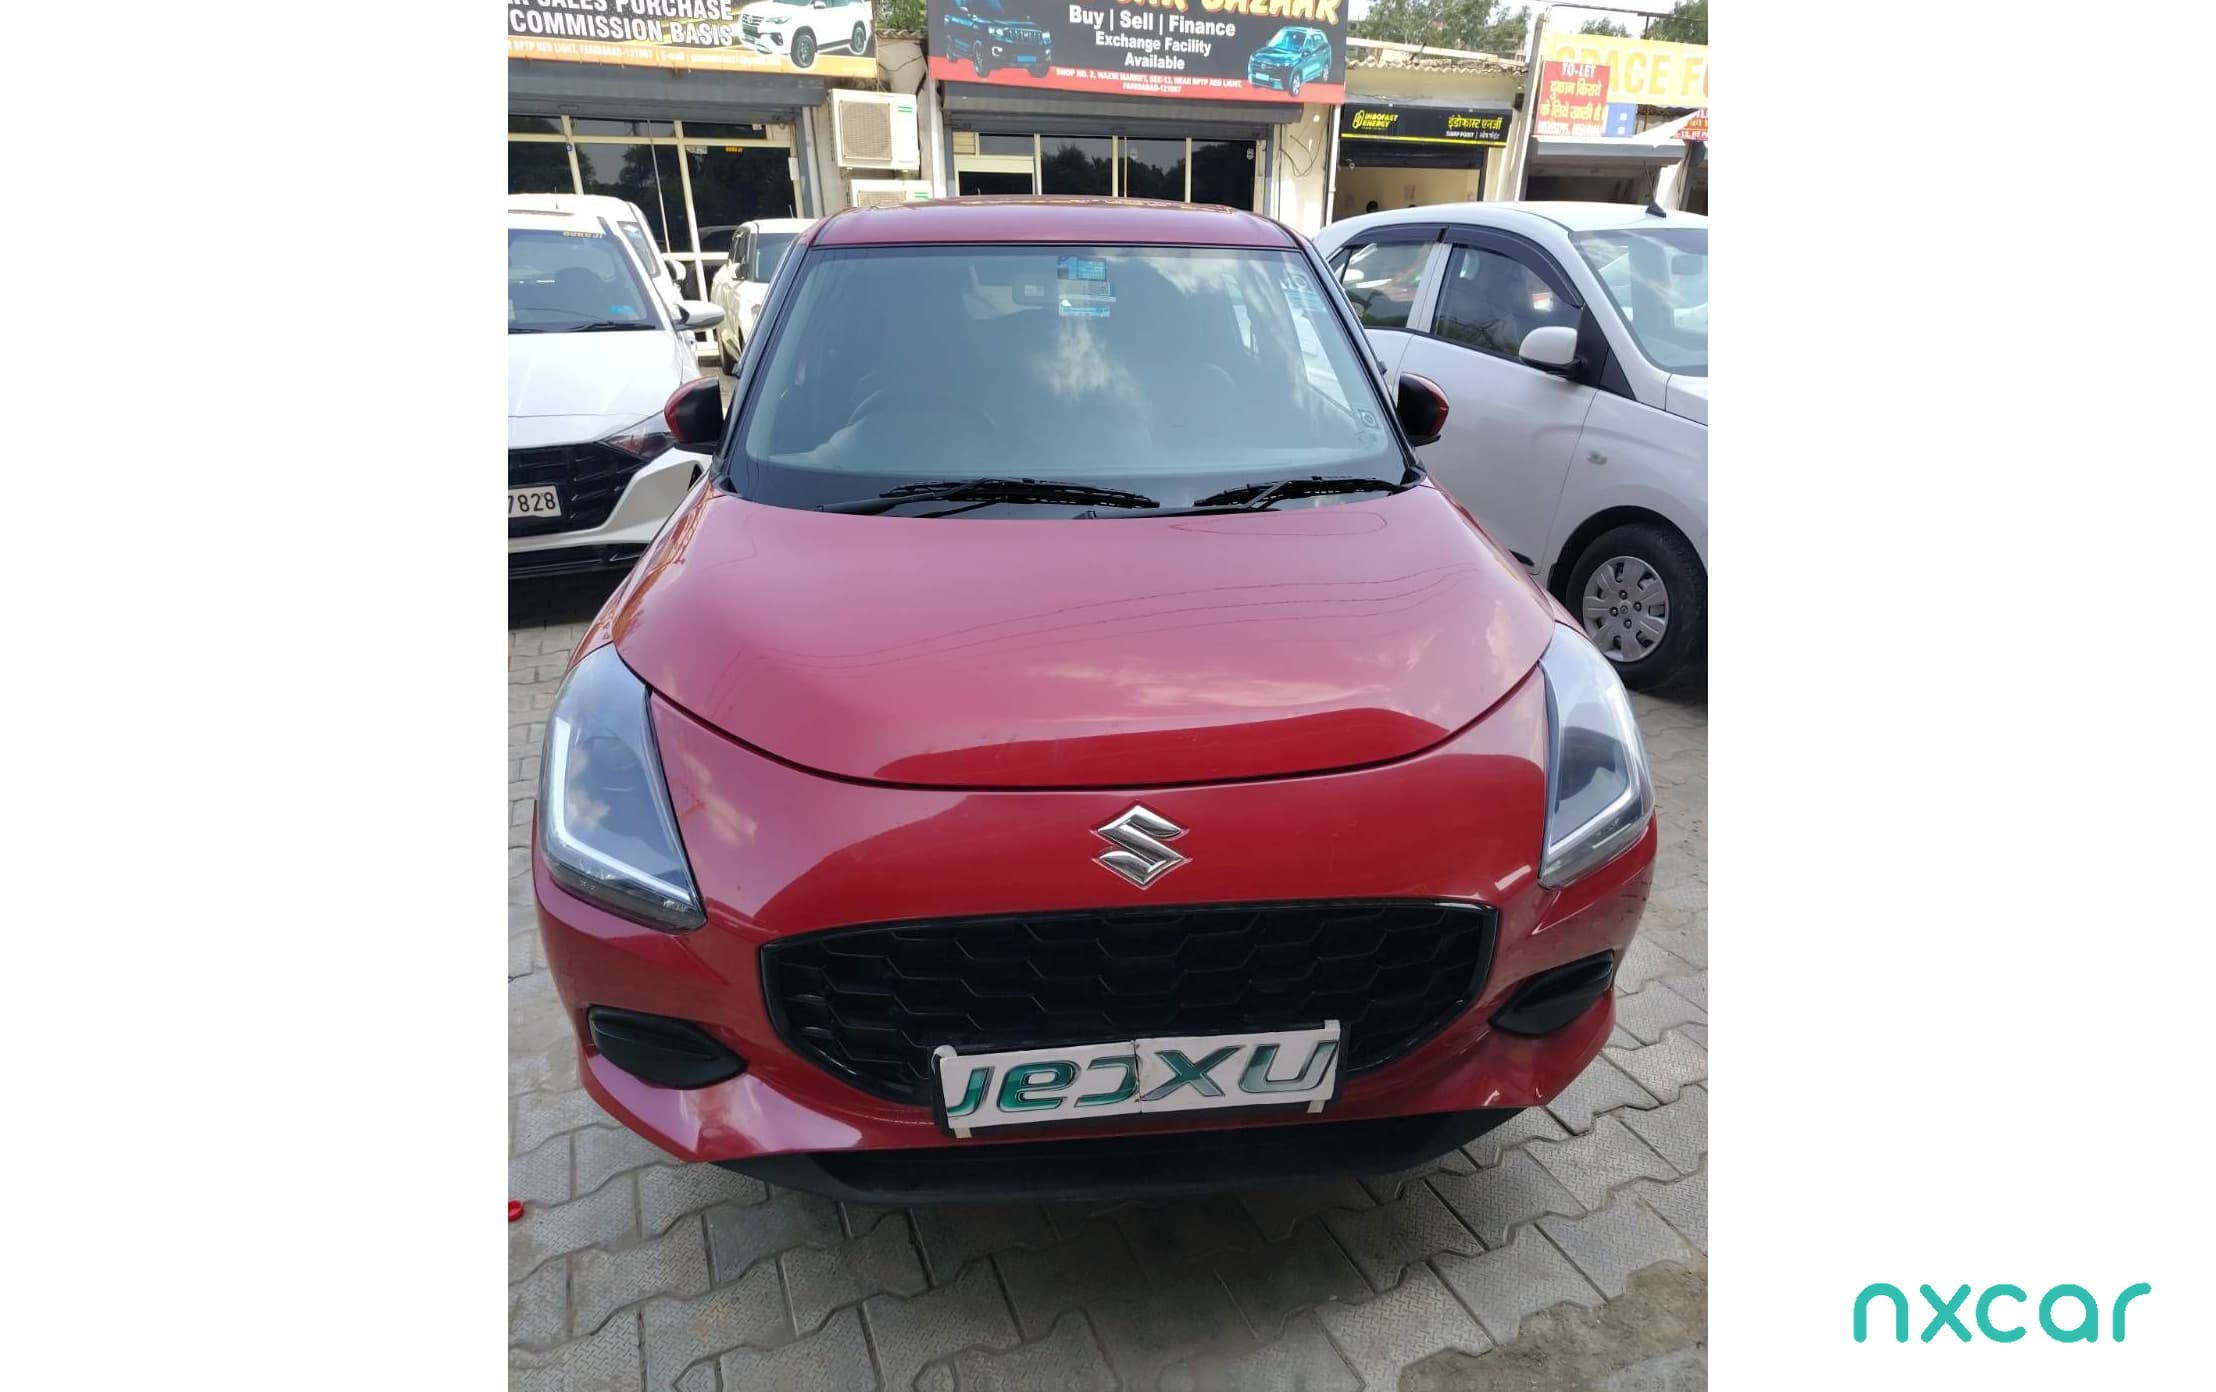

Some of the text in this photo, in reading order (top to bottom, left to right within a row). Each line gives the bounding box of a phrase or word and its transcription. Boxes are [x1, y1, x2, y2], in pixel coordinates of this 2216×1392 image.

[615, 0, 733, 20] PURCHASE
[1069, 5, 1104, 29] Buy
[1120, 10, 1153, 30] Sell
[1169, 15, 1236, 36] Finance
[510, 9, 733, 46] COMMISSION BASIS
[1095, 31, 1211, 56] Exchange Facility
[1124, 52, 1184, 70] Available
[1562, 62, 1595, 78] TO-LET
[1682, 57, 1708, 97] F
